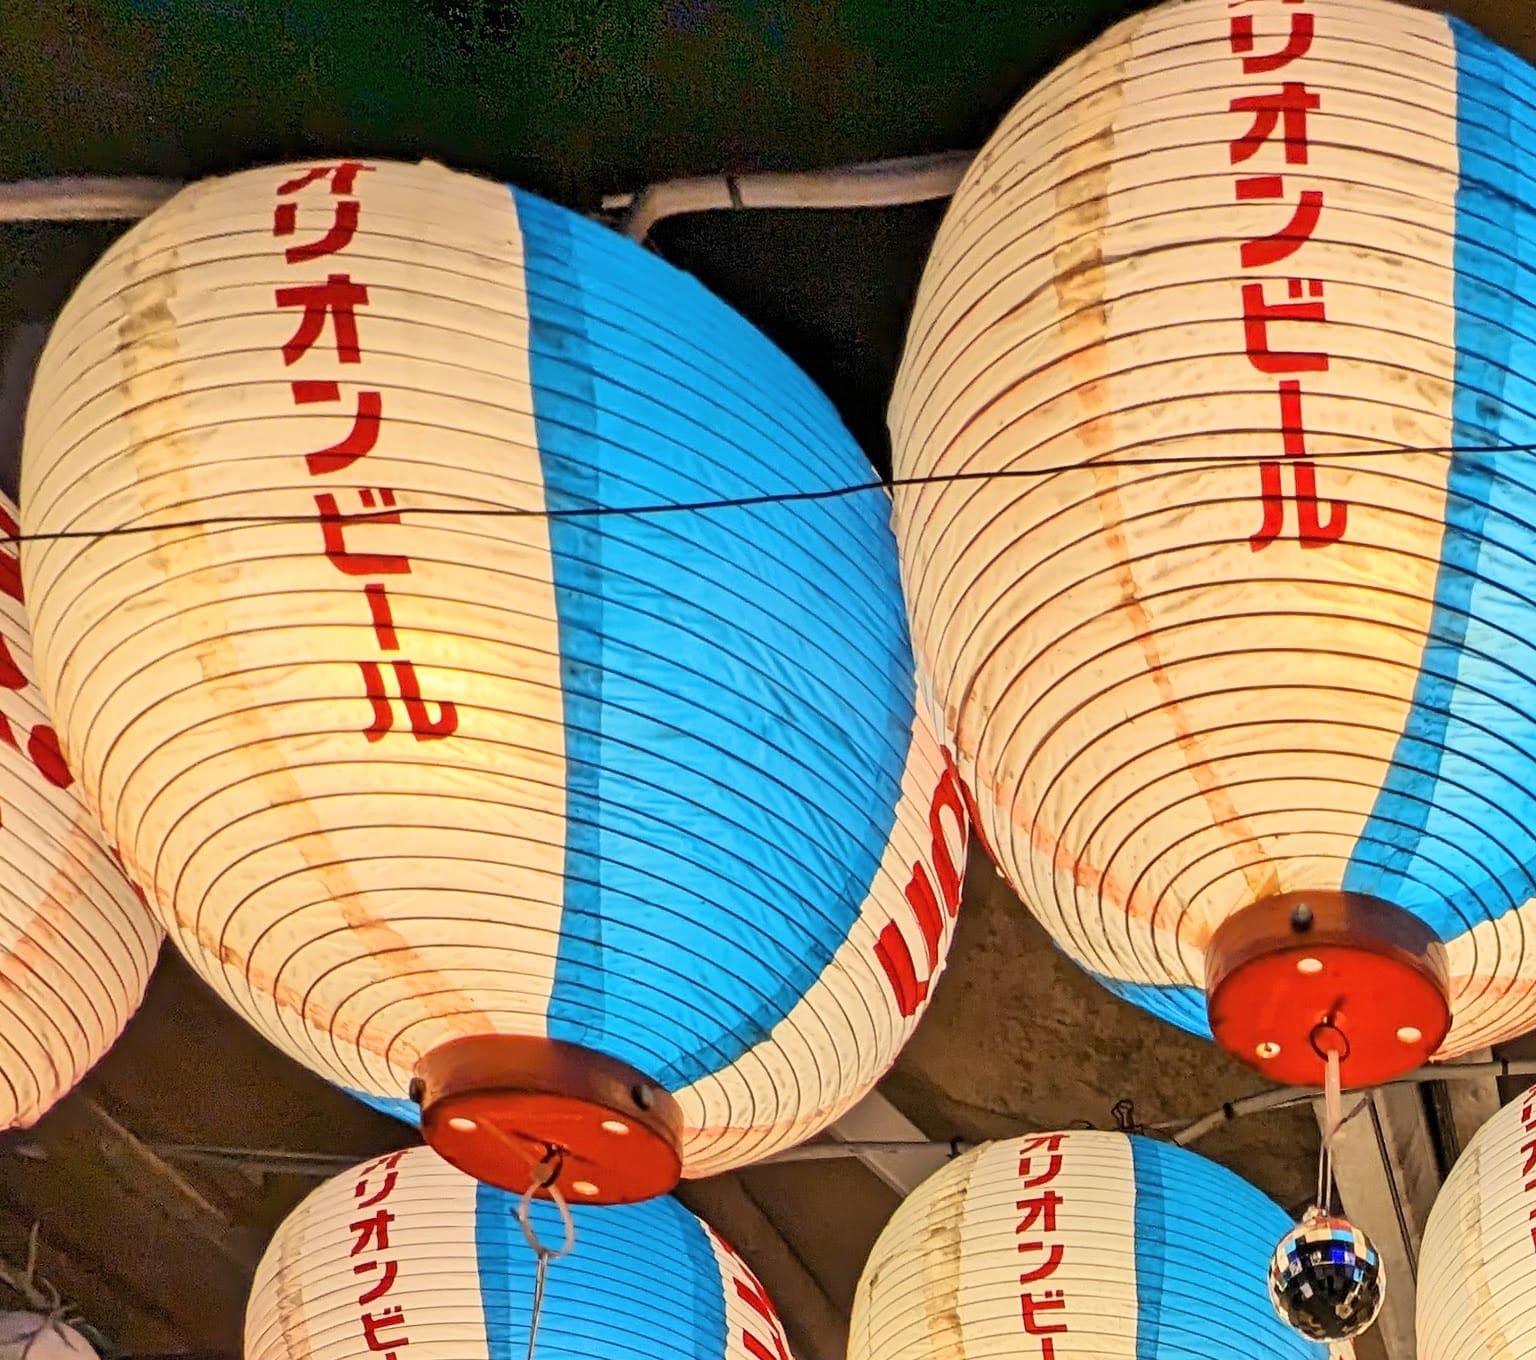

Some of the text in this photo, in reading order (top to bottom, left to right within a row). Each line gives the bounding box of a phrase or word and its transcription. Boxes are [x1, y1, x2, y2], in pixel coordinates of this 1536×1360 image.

[273, 160, 458, 742] オリオンビール
[1227, 0, 1352, 552] リオンビール
